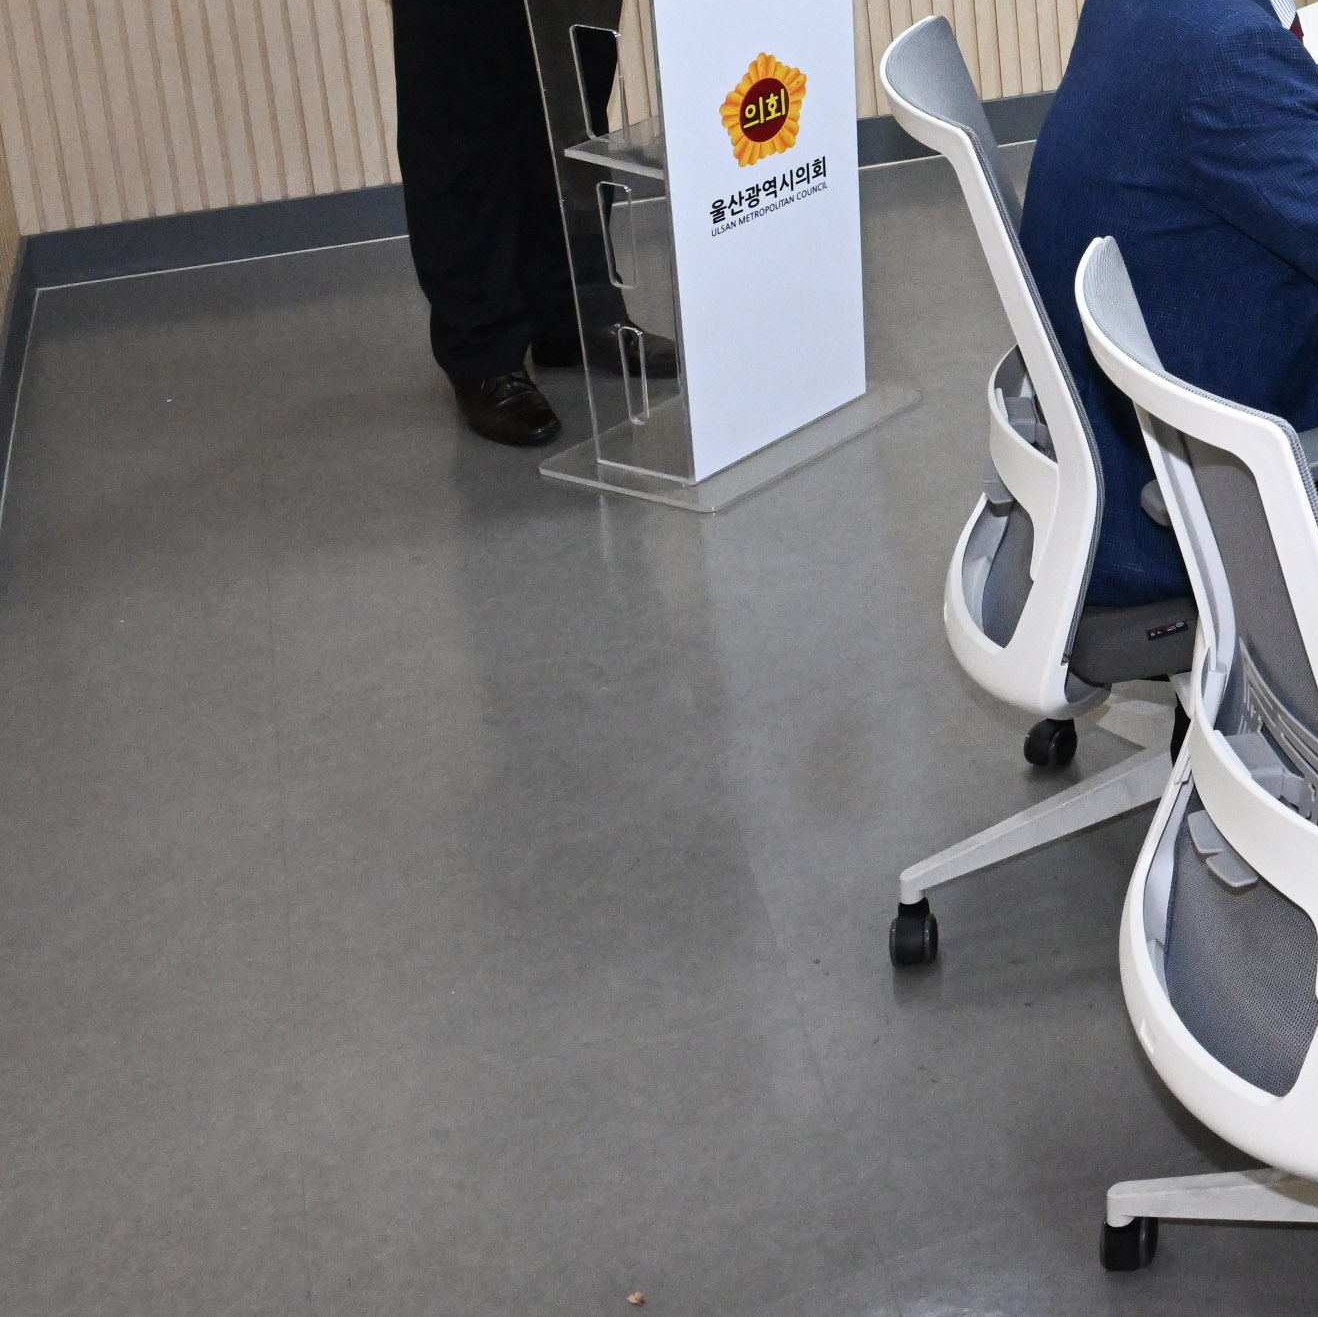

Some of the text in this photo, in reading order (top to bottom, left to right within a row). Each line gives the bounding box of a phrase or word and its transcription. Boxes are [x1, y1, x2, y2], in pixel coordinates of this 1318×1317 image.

[743, 88, 786, 129] 의회
[710, 156, 827, 224] 울산광역시의회
[711, 181, 828, 237] ULSAN METROPOLITAN COUNCIL
